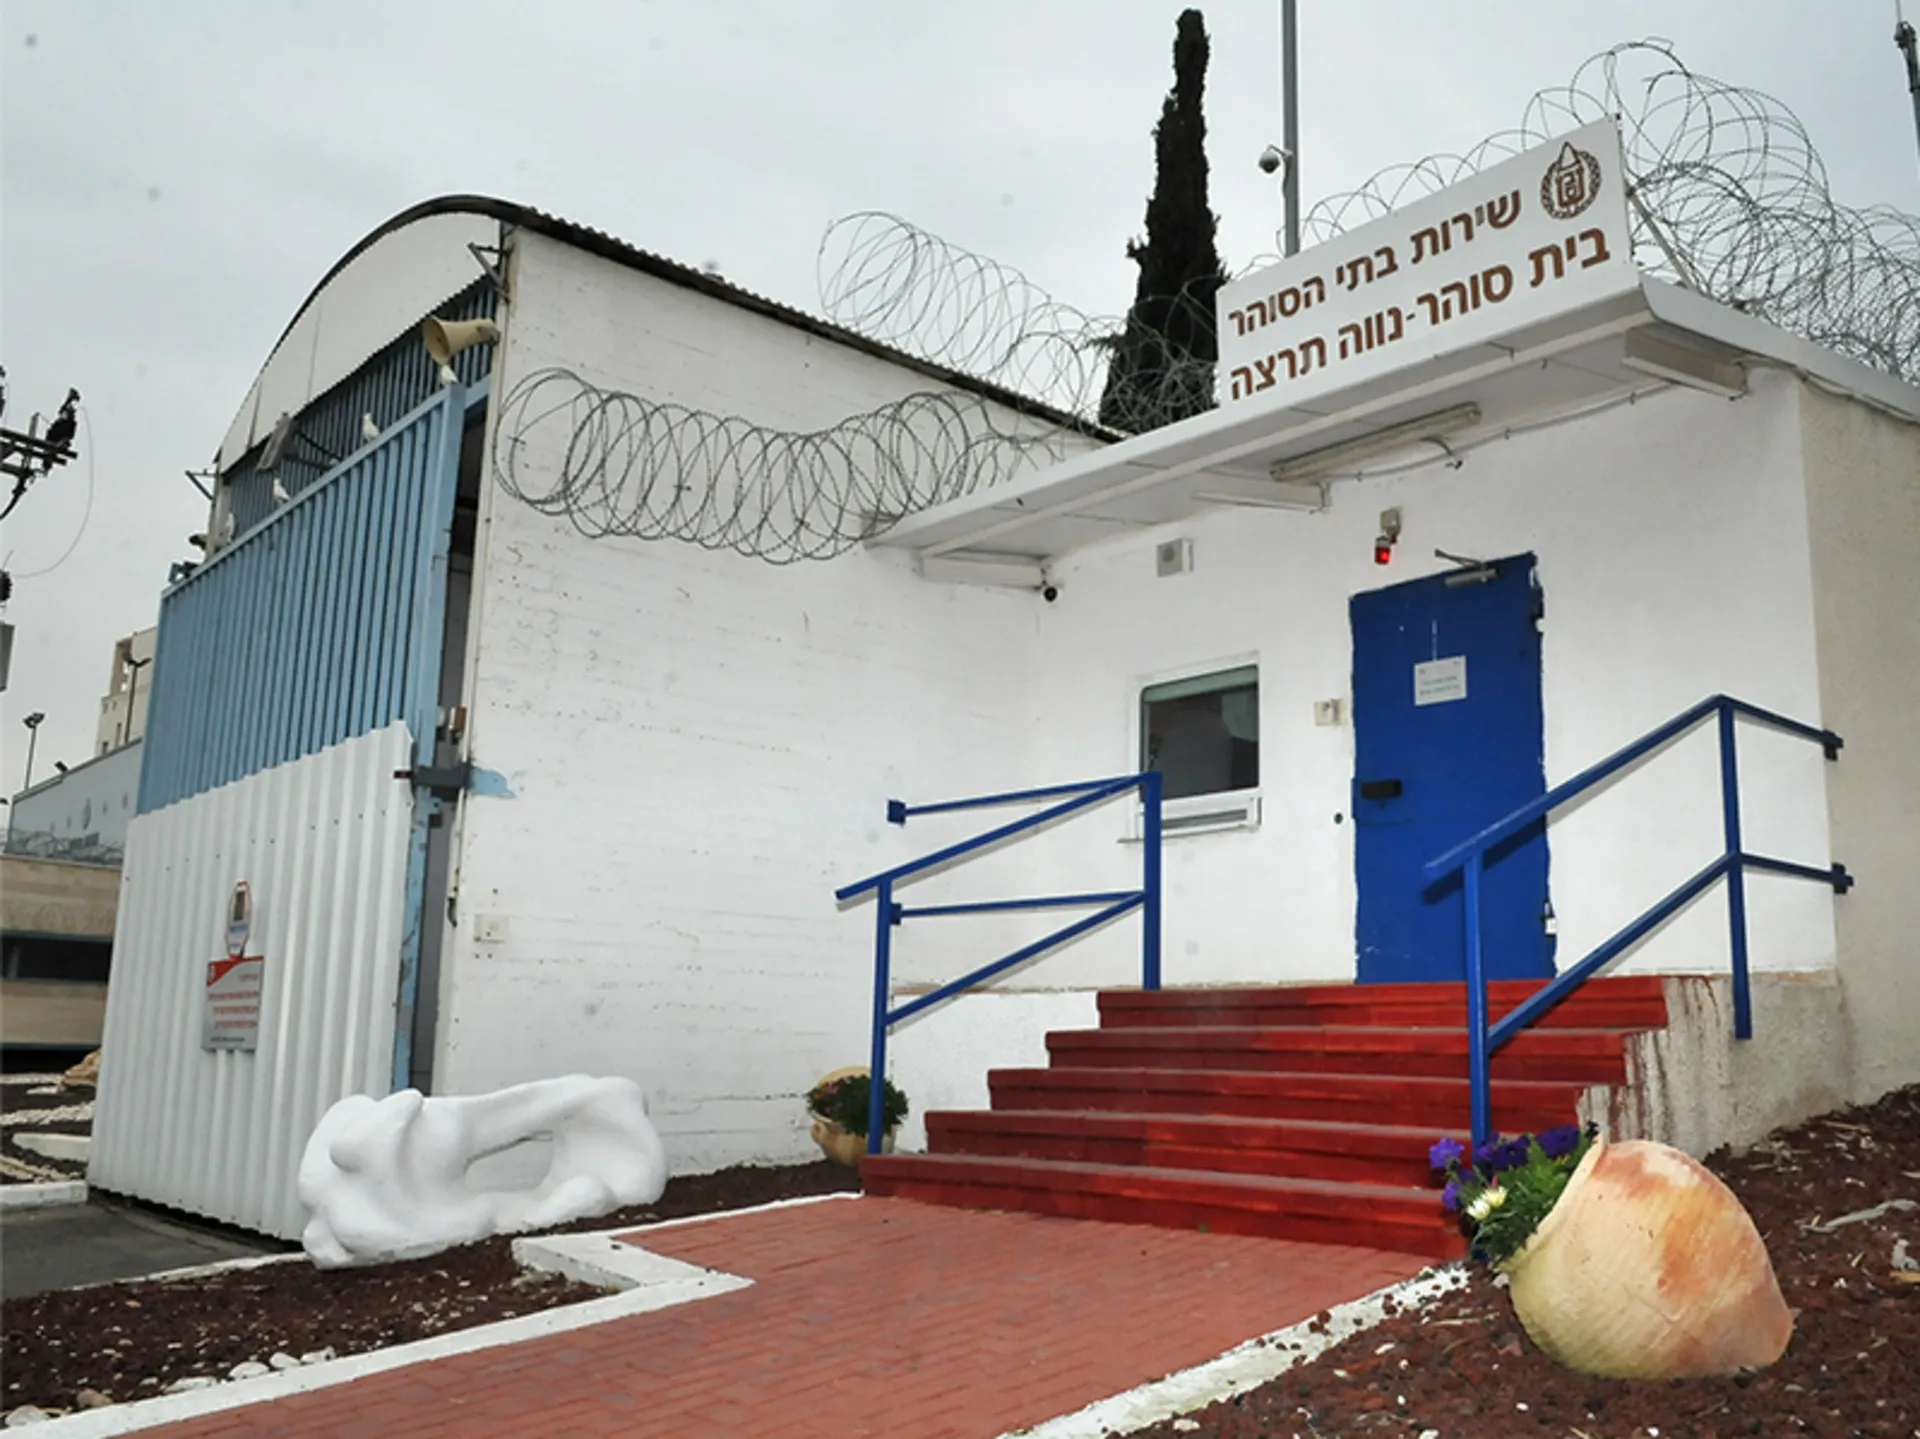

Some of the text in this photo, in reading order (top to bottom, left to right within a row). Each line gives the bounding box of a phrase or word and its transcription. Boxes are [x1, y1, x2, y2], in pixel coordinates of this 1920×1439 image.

[1228, 190, 1521, 336] שירות בתי הסוהר
[1528, 228, 1611, 287] בית
[1231, 335, 1327, 401] תרצה
